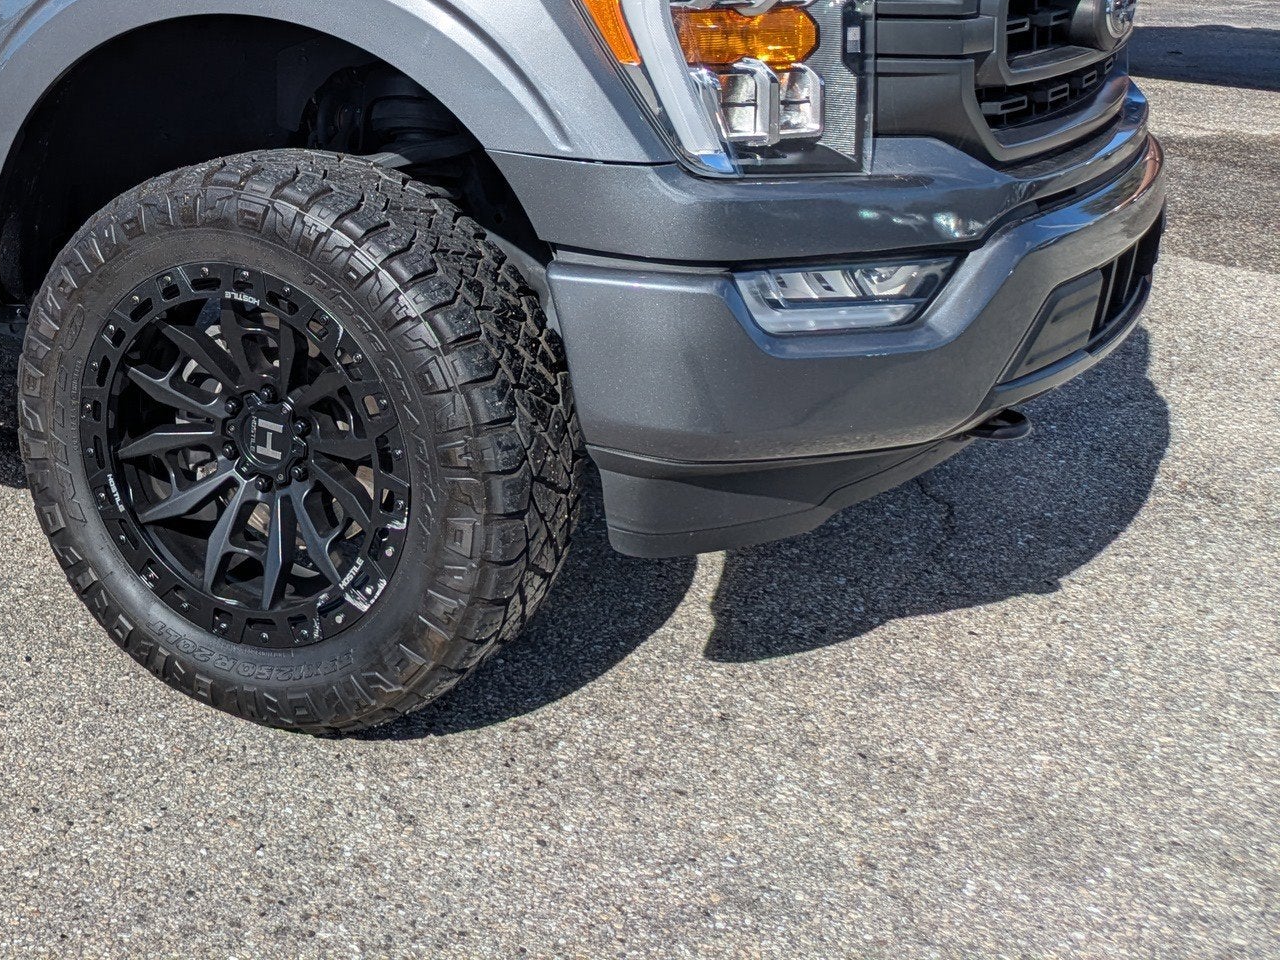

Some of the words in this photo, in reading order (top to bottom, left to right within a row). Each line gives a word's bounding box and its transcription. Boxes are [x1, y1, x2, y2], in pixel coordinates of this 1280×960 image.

[224, 290, 260, 307] HOSTILE
[256, 418, 284, 461] H
[106, 473, 126, 513] HOSTILE
[338, 556, 365, 590] HOSTILE
